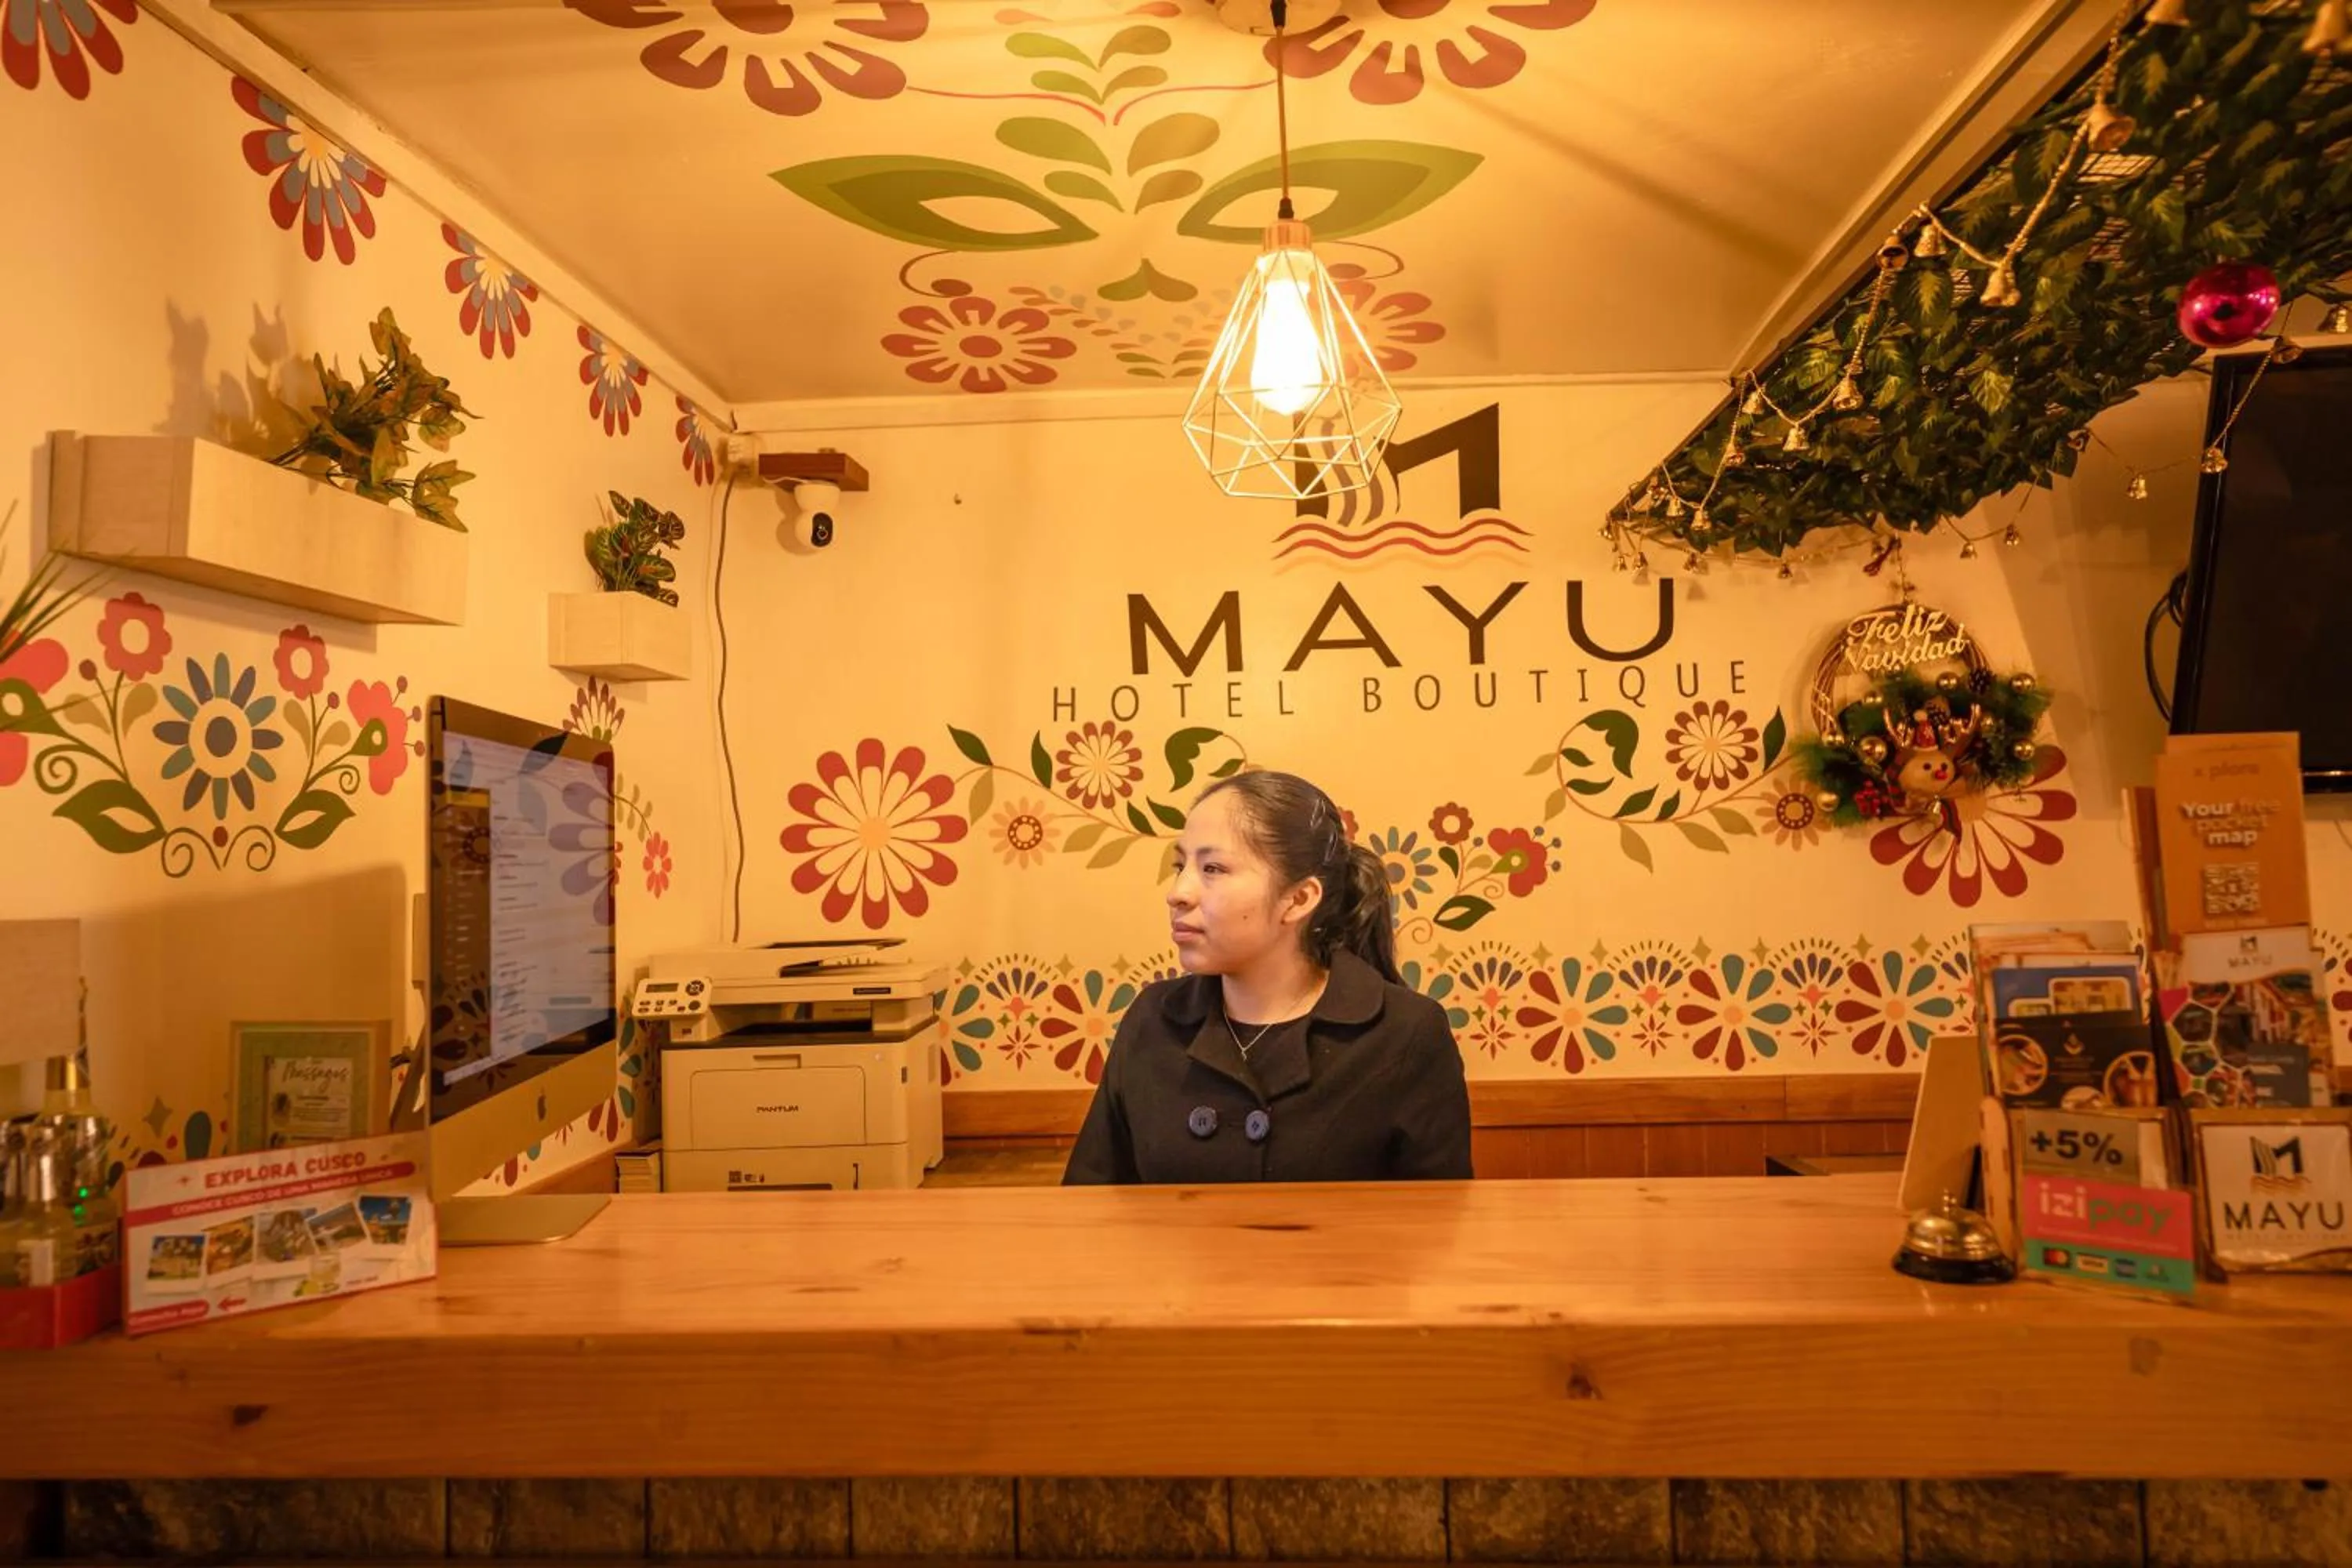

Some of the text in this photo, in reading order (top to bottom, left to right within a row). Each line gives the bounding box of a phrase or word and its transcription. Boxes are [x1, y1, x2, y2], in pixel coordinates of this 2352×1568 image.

[1127, 578, 1675, 676] MAYU
[1847, 603, 1951, 646] Feliz
[1845, 623, 1969, 672] Navidad
[1052, 660, 1746, 722] HOTEL BOUTIQUE
[2181, 801, 2234, 818] Your
[2207, 829, 2258, 847] map
[2029, 1129, 2123, 1166] +5%
[205, 1151, 365, 1189] EXPLORA CUSCO
[2039, 1181, 2172, 1236] izipay
[2223, 1201, 2344, 1231] MAYU
